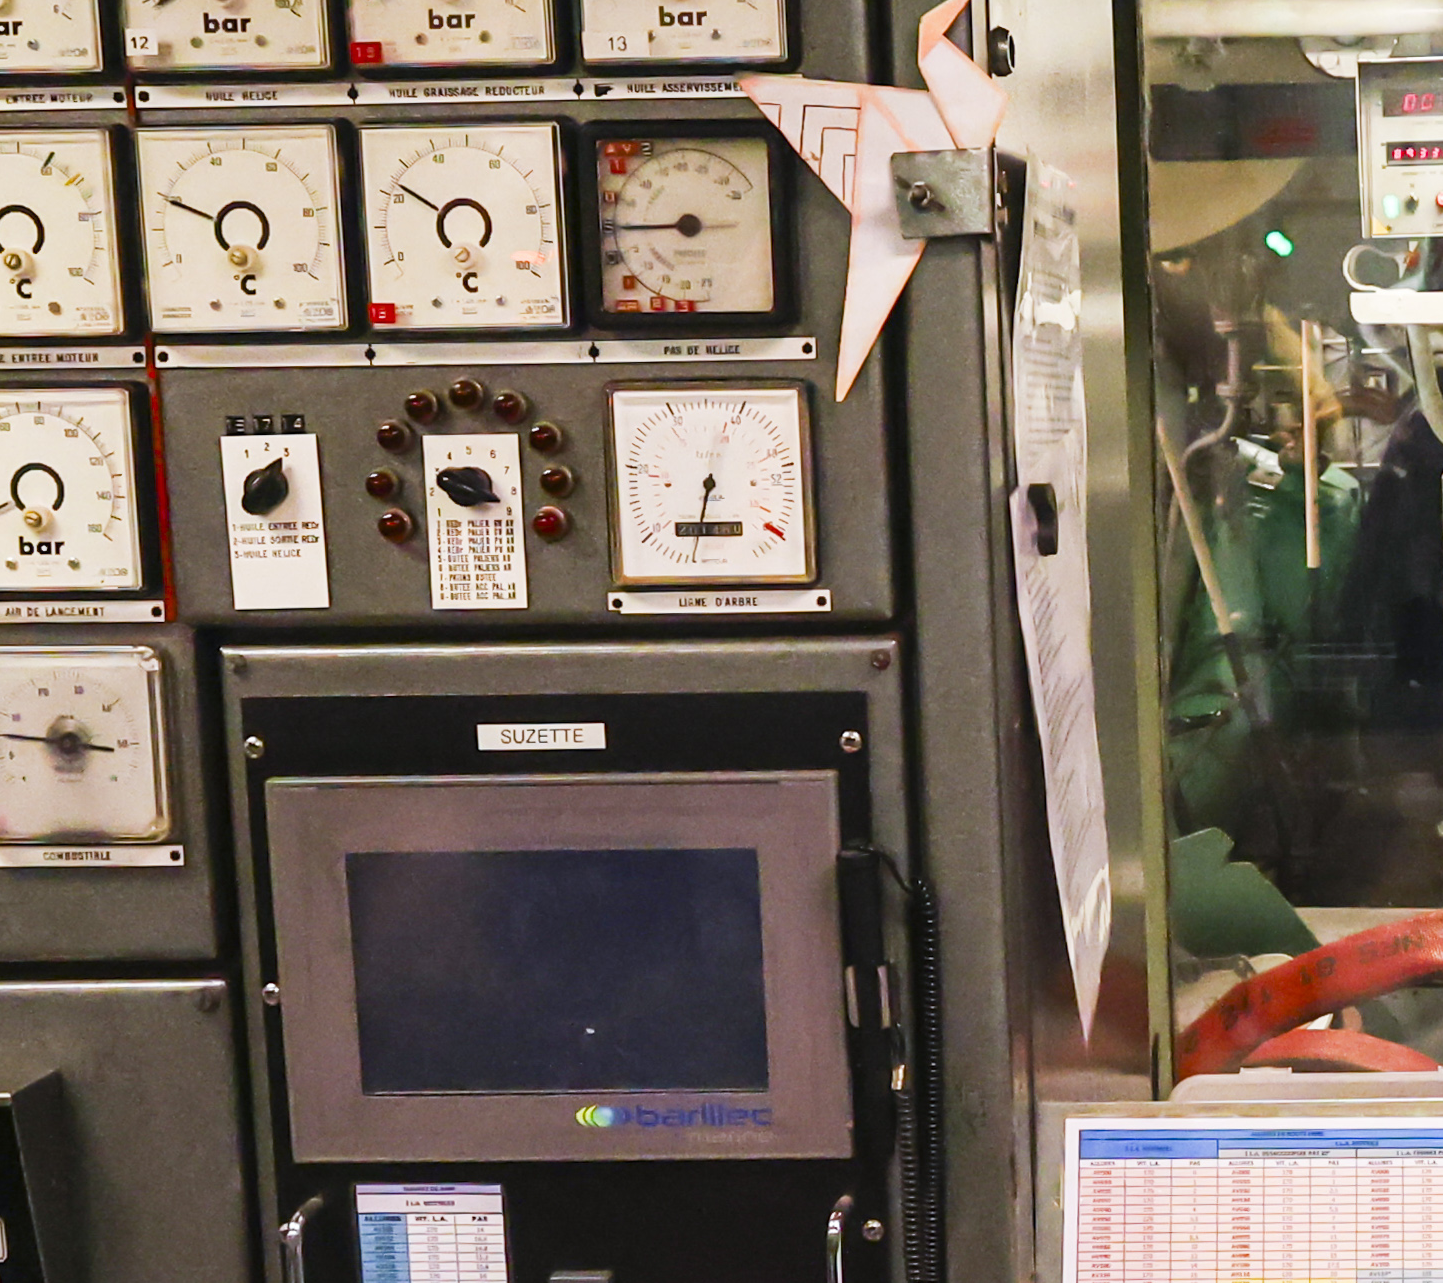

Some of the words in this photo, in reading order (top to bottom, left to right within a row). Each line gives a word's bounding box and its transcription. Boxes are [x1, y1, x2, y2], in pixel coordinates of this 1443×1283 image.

[203, 12, 252, 34] bar
[428, 8, 476, 30] bar
[658, 5, 708, 27] bar
[130, 35, 150, 50] 12
[608, 35, 628, 52] 13
[484, 84, 546, 97] REDUCTEUR
[9, 278, 33, 300] °C
[233, 274, 257, 296] °C
[455, 272, 479, 294] °C
[17, 535, 65, 556] bar
[500, 728, 584, 745] SUZETTE
